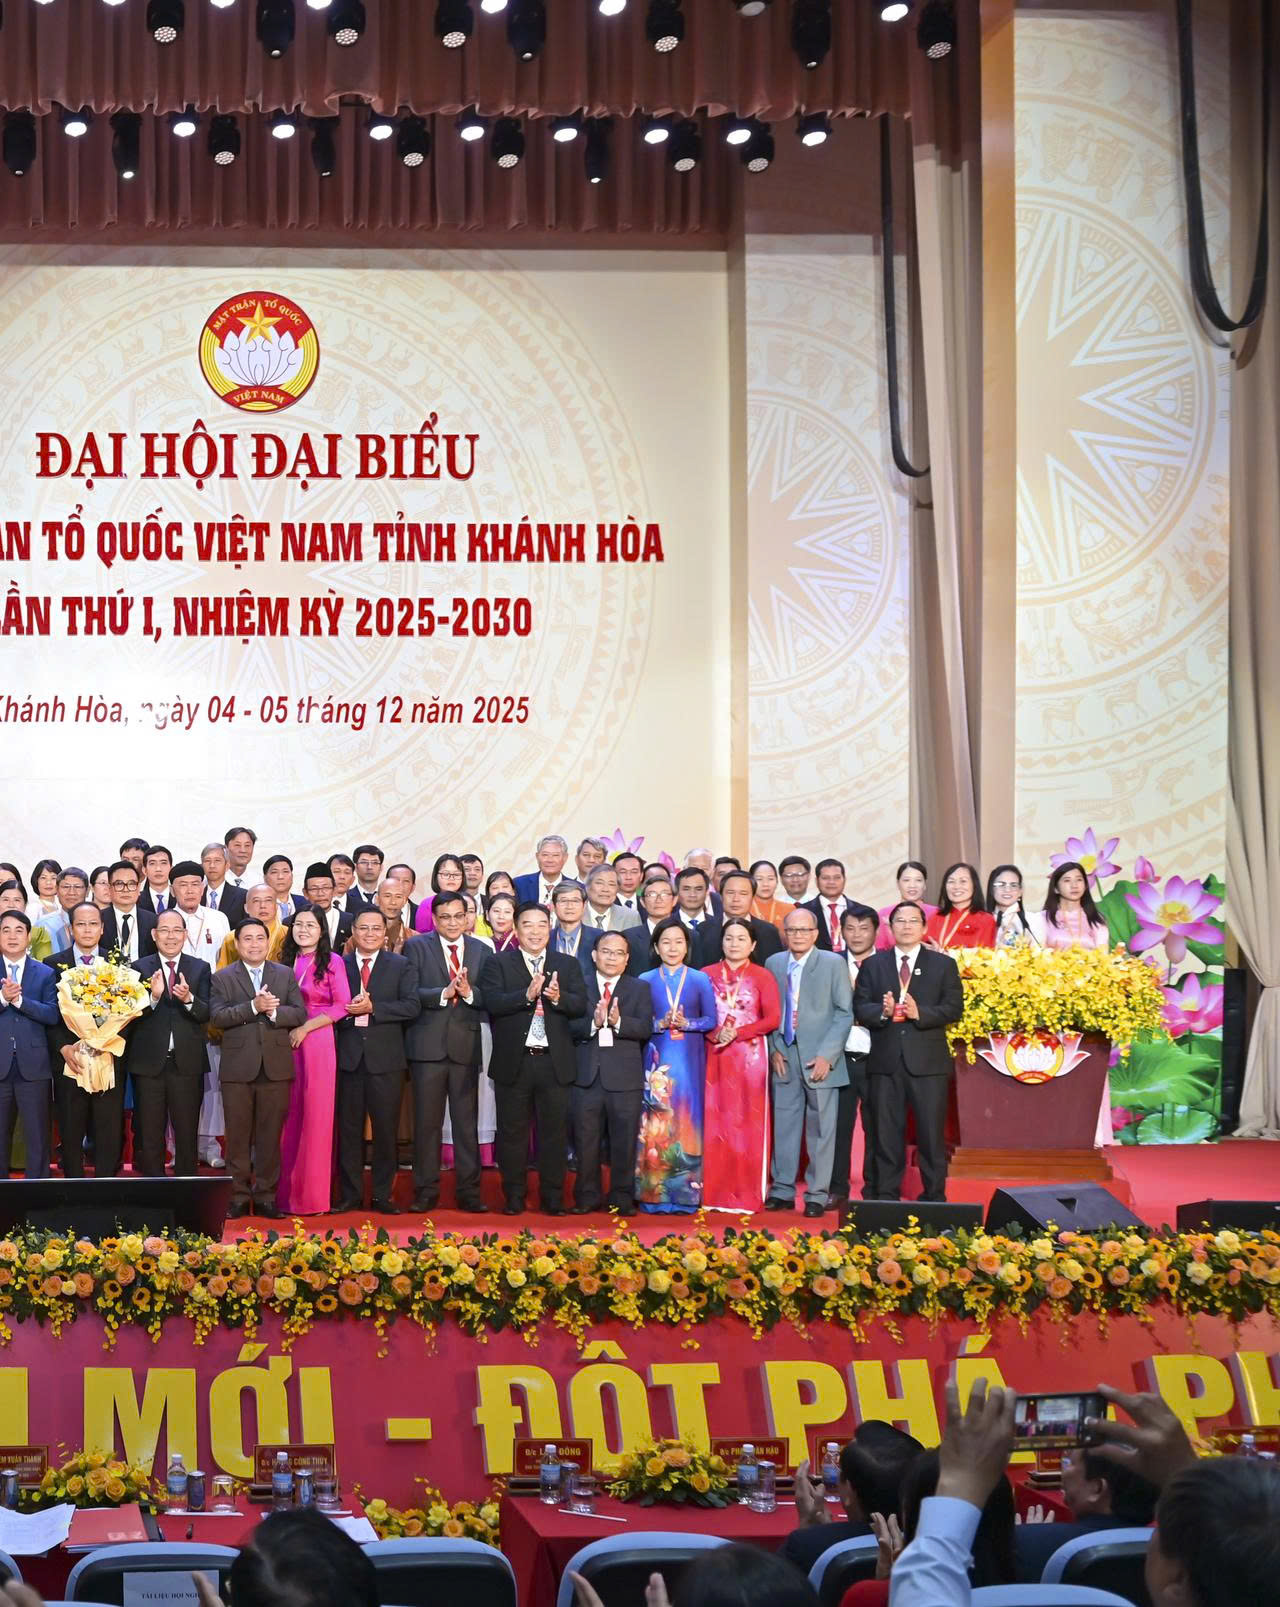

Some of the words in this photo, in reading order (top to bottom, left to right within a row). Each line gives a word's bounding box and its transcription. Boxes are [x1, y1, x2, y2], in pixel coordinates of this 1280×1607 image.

[278, 304, 303, 326] QUỐC
[232, 389, 259, 404] VIỆT
[260, 390, 285, 404] NAM
[35, 431, 128, 491] ĐẠI
[140, 418, 239, 491] HỘI
[250, 432, 343, 491] ĐẠI
[355, 411, 480, 482] BIỂU
[41, 504, 85, 561] TỔ
[96, 507, 184, 569] QUỐC
[193, 513, 271, 570] VIỆT
[280, 522, 363, 562] NAM
[372, 511, 457, 562] TỈNH
[467, 515, 586, 563] KHÁNH
[596, 515, 665, 563] HÒA
[61, 588, 134, 636] THỨ
[143, 596, 162, 642] I,
[173, 588, 290, 645] NHIỆM
[299, 588, 345, 637] KỲ
[355, 597, 532, 638] 2025-2030
[73, 694, 129, 727] Hòa,
[207, 695, 236, 723] 04
[260, 695, 289, 724] 05
[296, 694, 367, 731] tháng
[376, 695, 404, 724] 12
[410, 695, 464, 724] năm
[472, 695, 530, 724] 2025
[83, 1343, 336, 1479] MỚI
